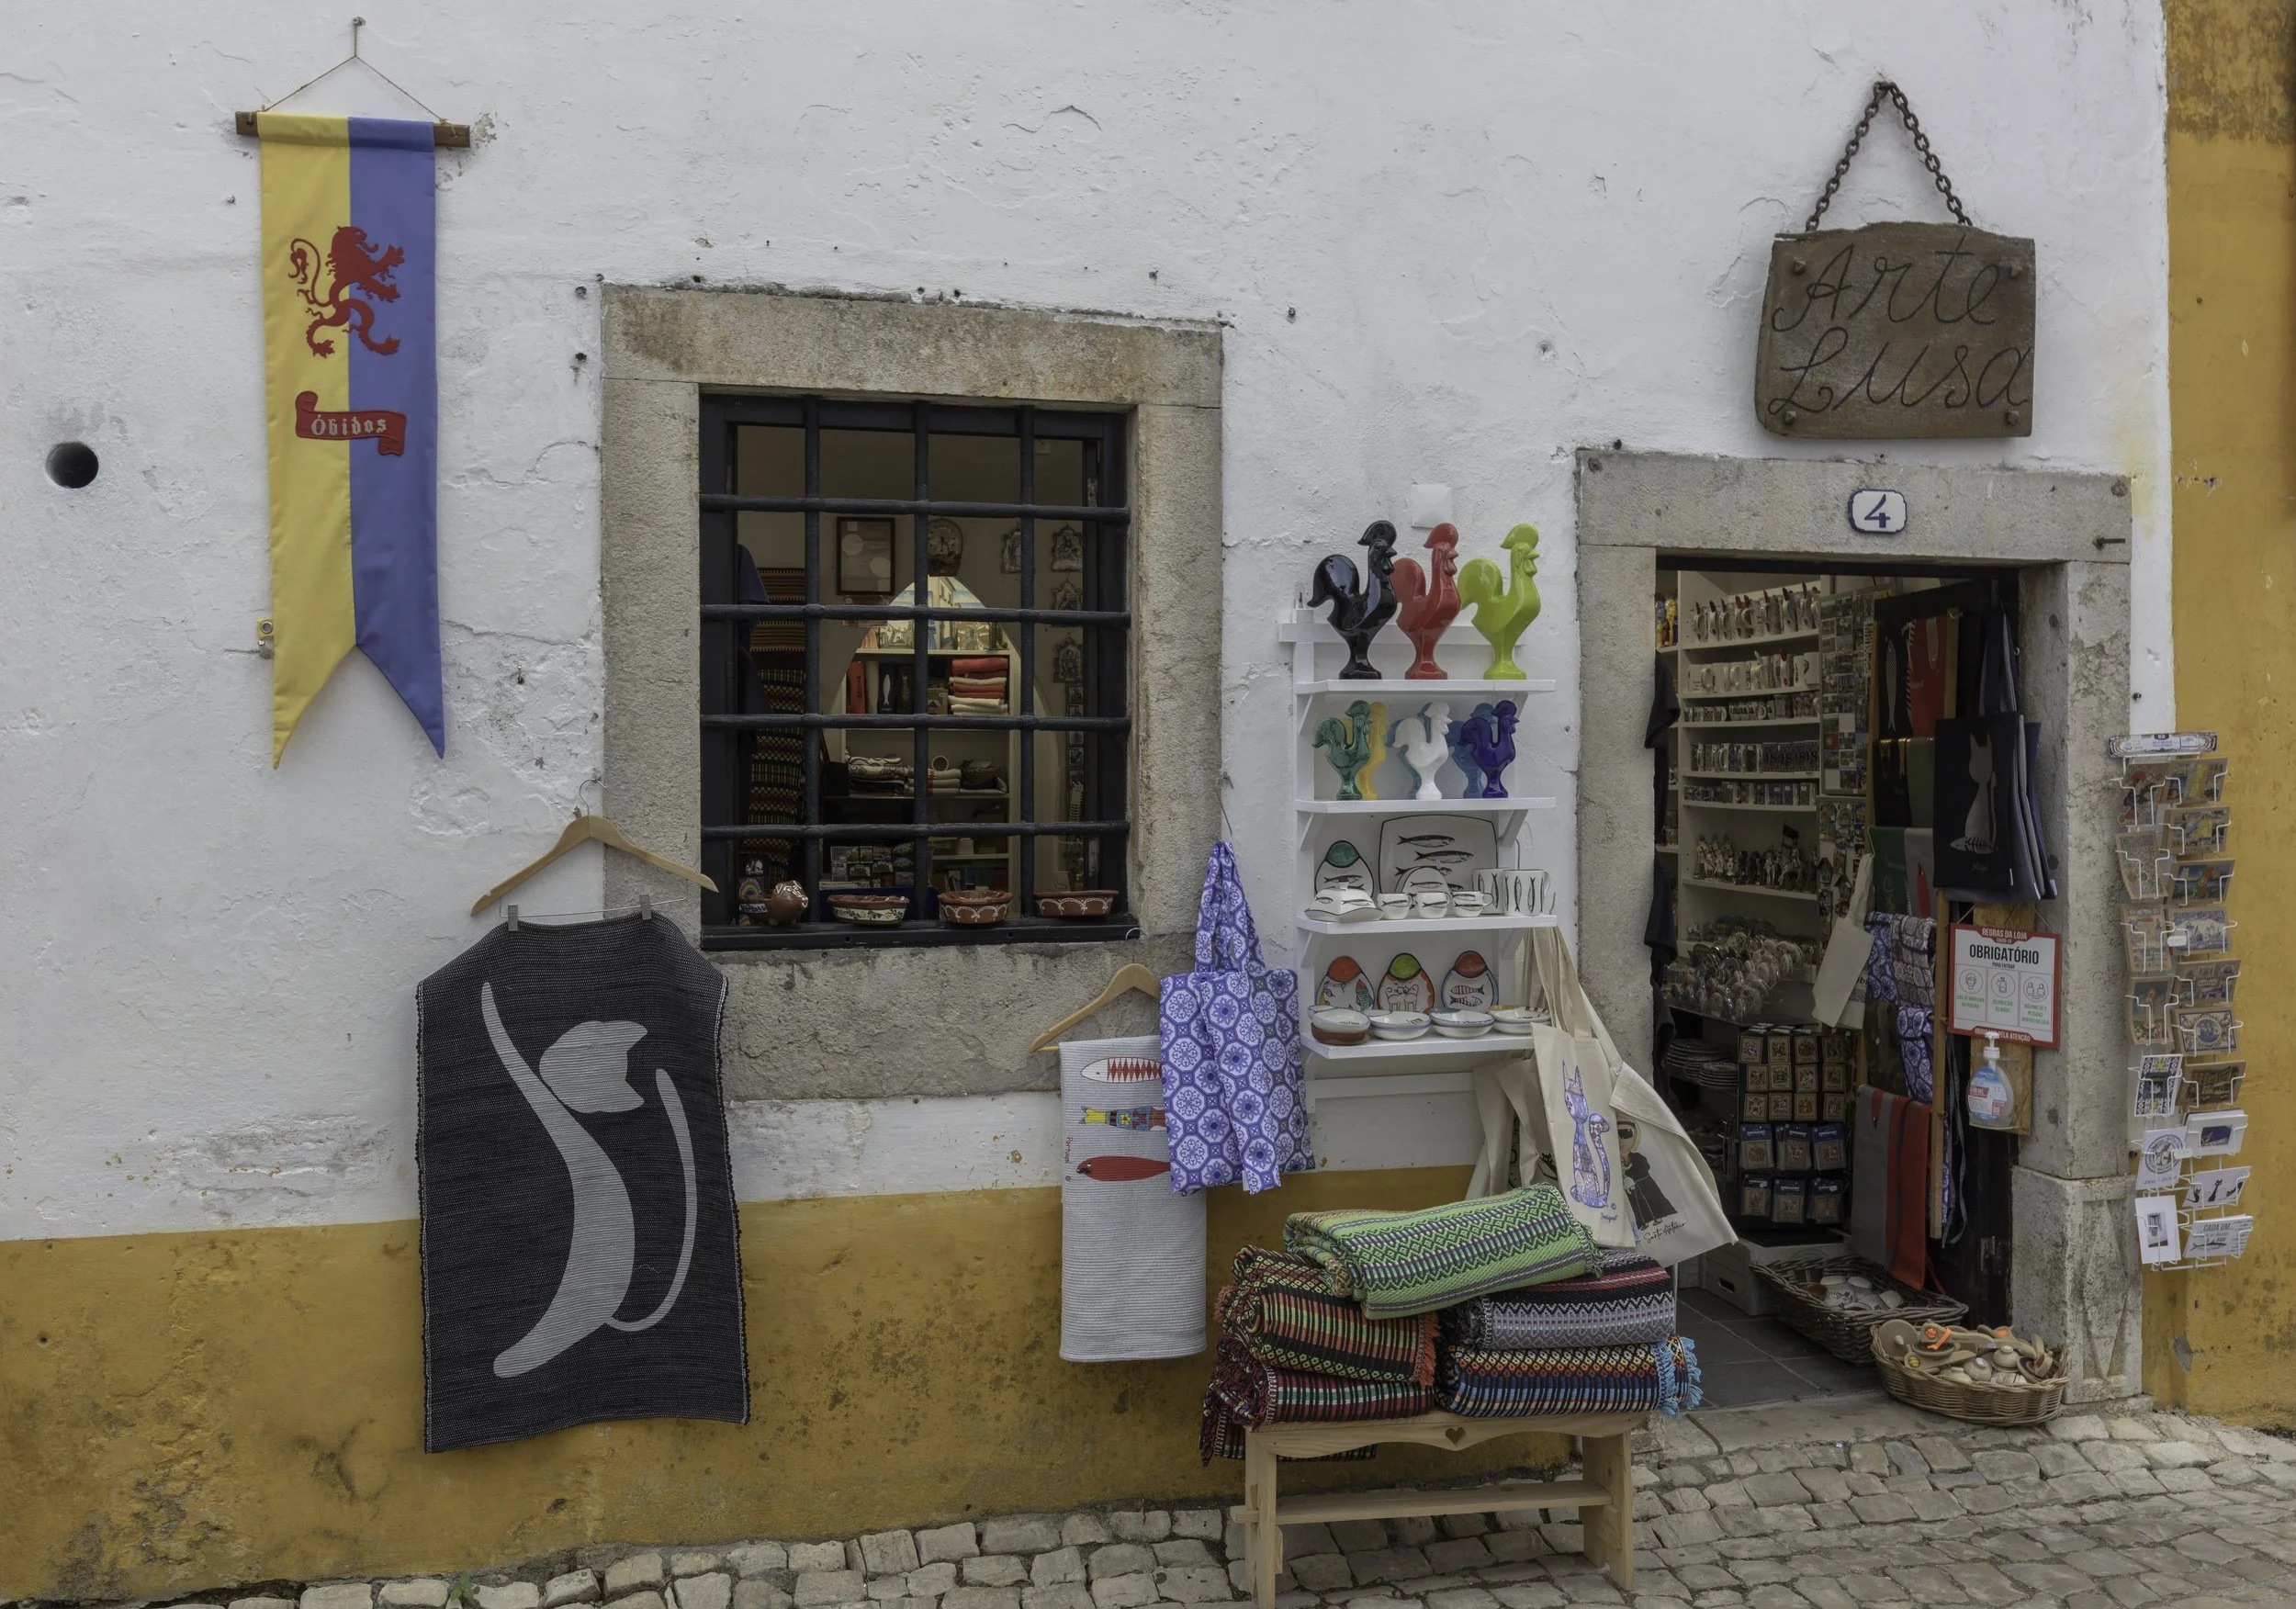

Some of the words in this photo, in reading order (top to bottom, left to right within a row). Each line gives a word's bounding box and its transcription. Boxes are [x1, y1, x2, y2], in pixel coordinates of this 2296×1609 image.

[1771, 232, 1999, 332] Arte
[1767, 327, 2032, 414] Lusa
[310, 414, 387, 435] Óbidos
[1863, 493, 1891, 528] 4
[1982, 928, 2004, 938] REGRAS
[2005, 930, 2013, 939] DA
[2014, 931, 2027, 940] LOJA
[1969, 943, 2039, 964] OBRIGATÓRIO
